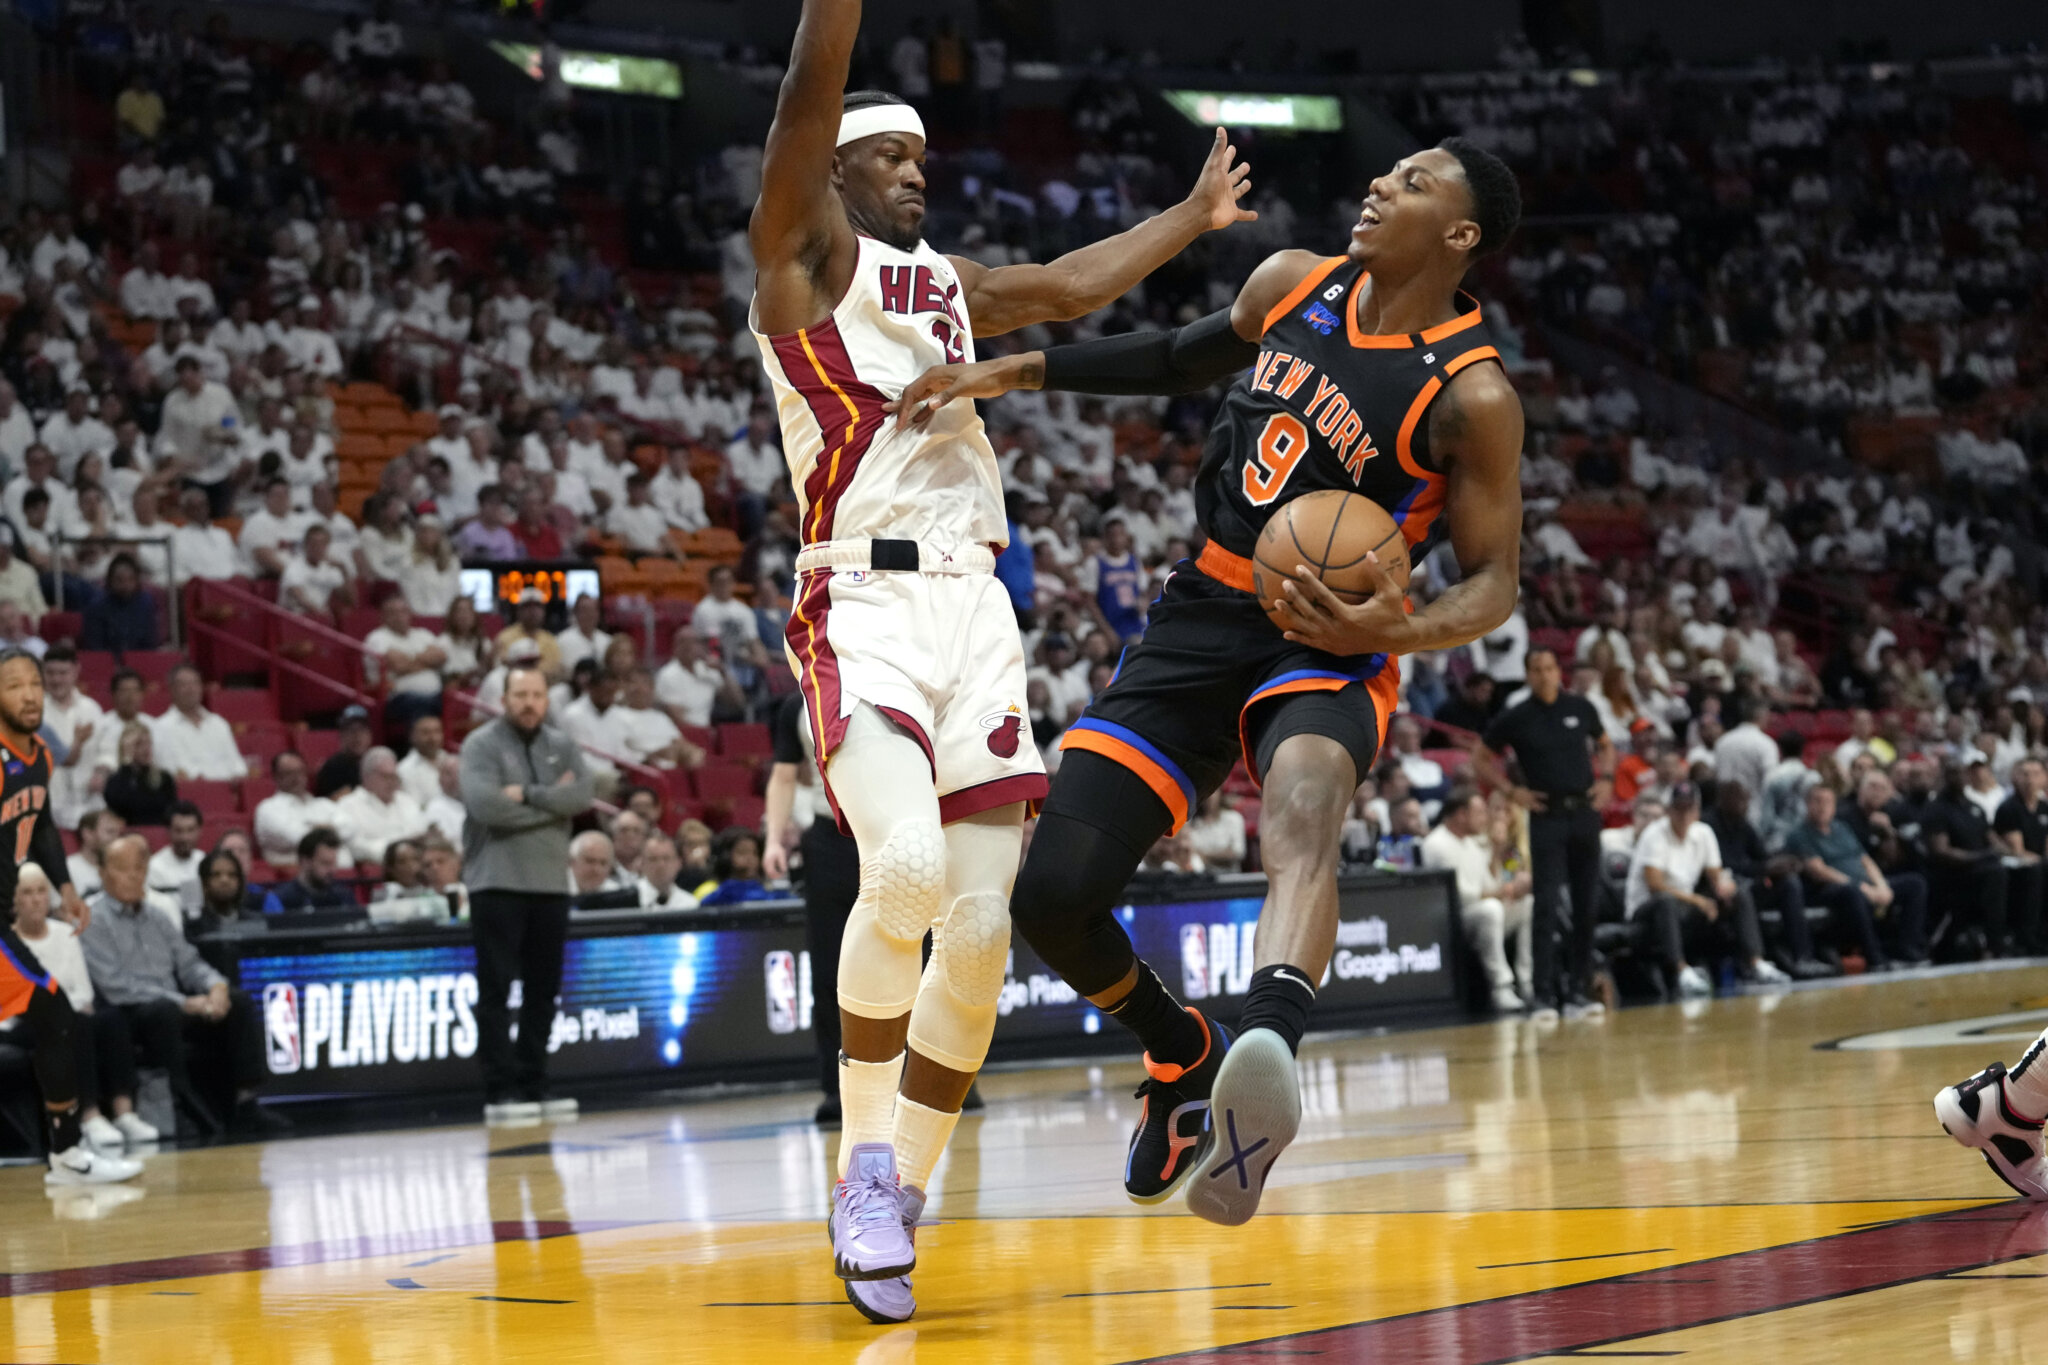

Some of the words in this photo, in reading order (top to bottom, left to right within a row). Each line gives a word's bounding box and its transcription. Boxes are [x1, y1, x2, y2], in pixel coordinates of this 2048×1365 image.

[1323, 284, 1344, 301] 6
[1302, 301, 1340, 335] NYC
[1251, 351, 1315, 400] NEW
[1303, 374, 1379, 487] YORK
[1242, 411, 1310, 507] 9
[1334, 946, 1399, 984] Google
[1399, 942, 1442, 973] Pixel
[304, 973, 480, 1070] PLAYOFFS
[581, 1005, 640, 1041] Pixel
